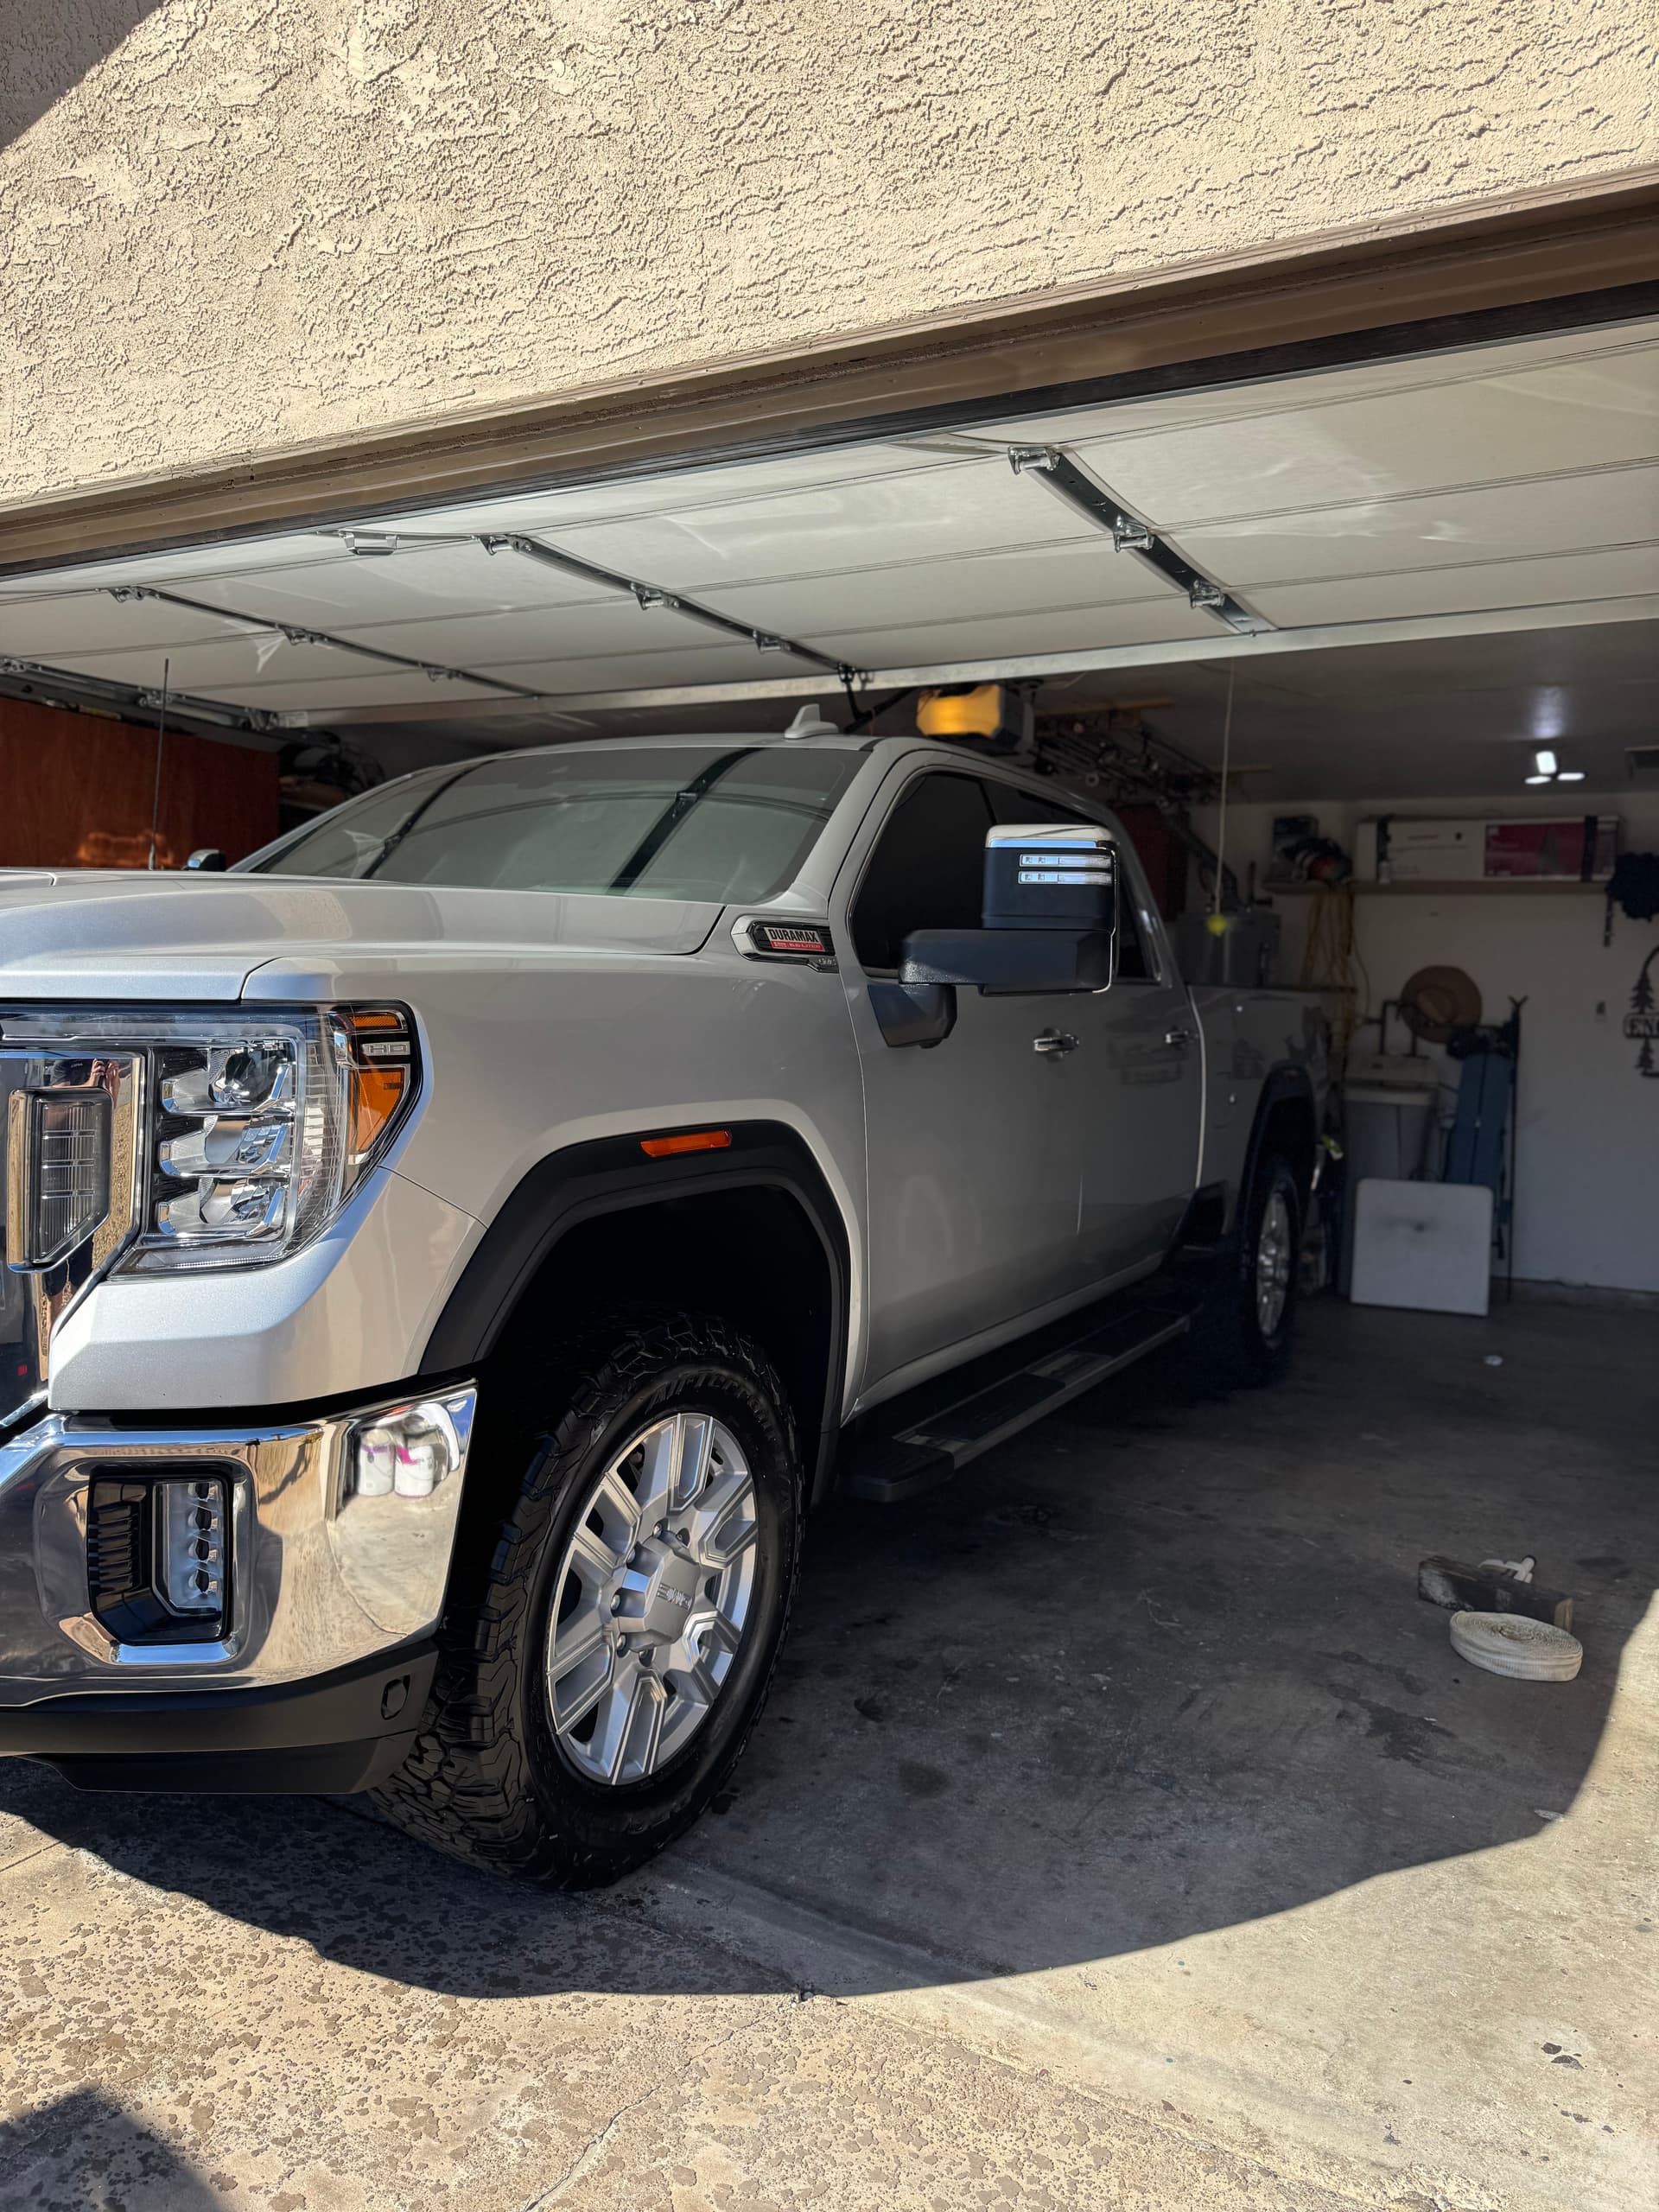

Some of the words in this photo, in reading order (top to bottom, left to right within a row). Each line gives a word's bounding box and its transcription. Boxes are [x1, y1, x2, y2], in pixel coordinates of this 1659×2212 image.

[768, 929, 819, 943] DURAMAX
[369, 1043, 407, 1054] HD
[657, 1583, 693, 1611] GMC
